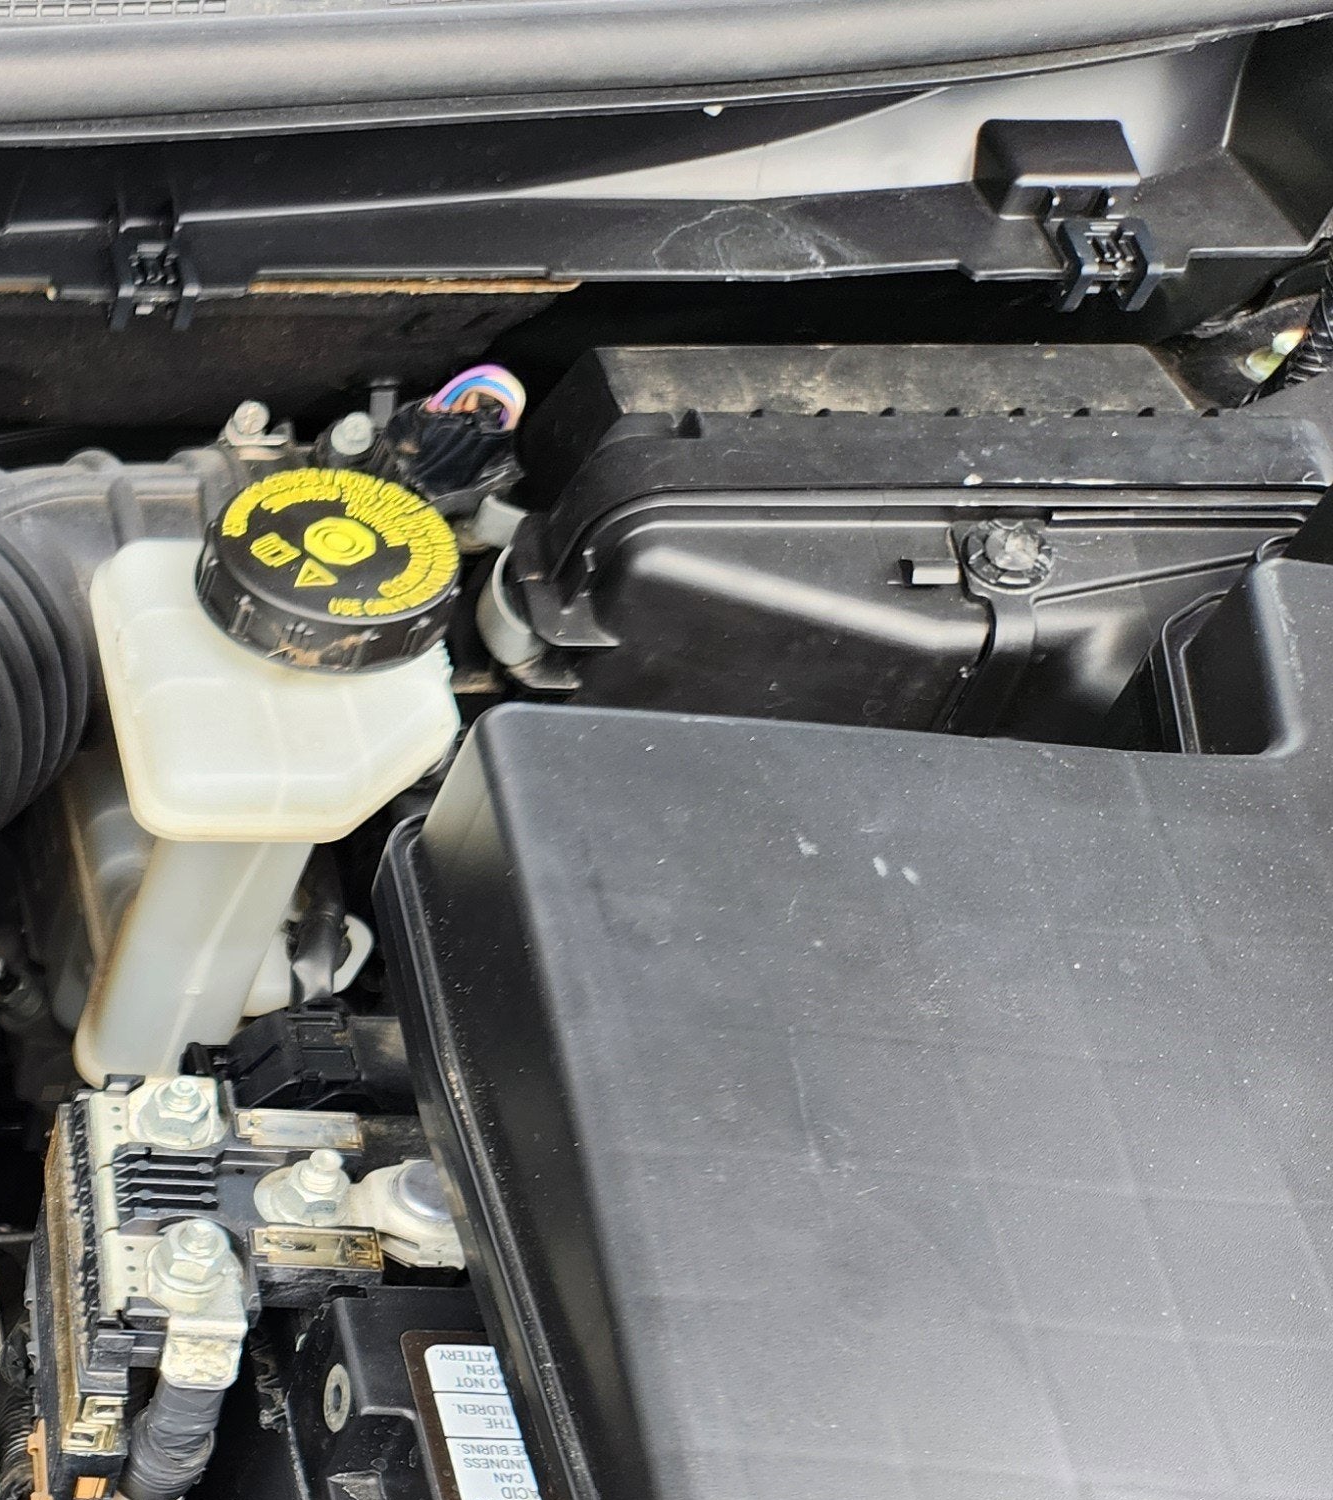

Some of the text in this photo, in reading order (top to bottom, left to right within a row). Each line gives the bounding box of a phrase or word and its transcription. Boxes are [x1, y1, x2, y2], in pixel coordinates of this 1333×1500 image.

[436, 1349, 493, 1362] ATTERY.
[465, 1364, 496, 1376] PEN
[455, 1377, 486, 1389] NOT
[452, 1403, 512, 1416] ILDREN.
[485, 1418, 514, 1430] THE
[493, 1472, 525, 1484] CAN
